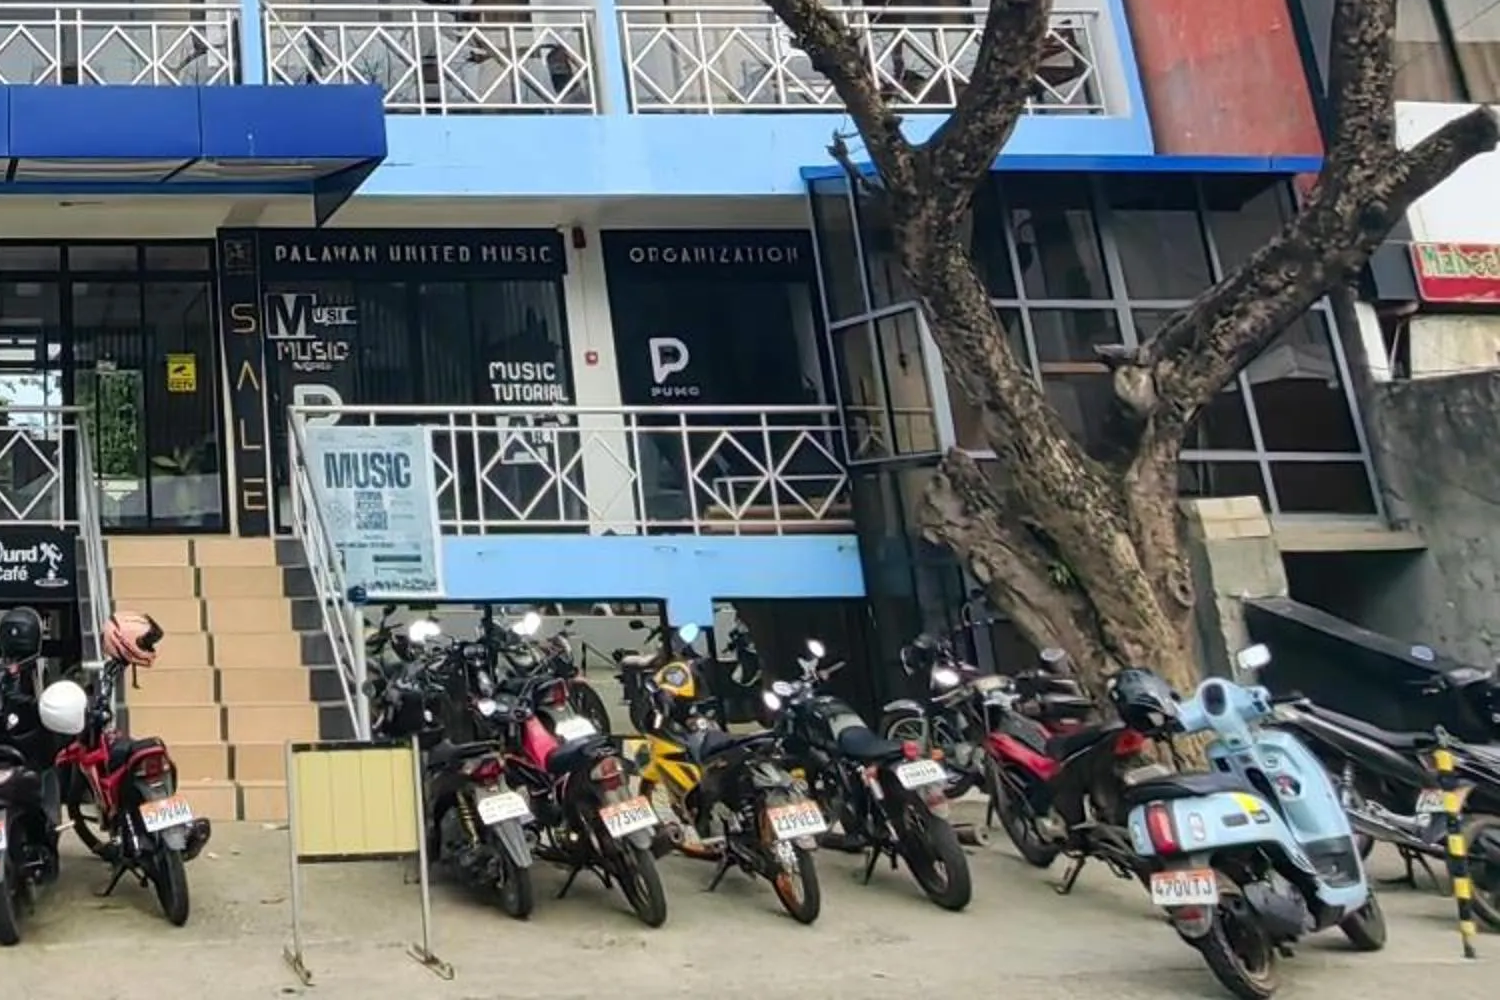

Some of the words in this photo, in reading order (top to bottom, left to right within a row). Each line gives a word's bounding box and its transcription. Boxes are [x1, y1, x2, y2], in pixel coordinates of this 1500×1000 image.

[275, 245, 377, 262] PALAWAN
[389, 245, 470, 262] UNITED
[482, 245, 553, 262] MUSIC
[629, 247, 799, 264] ORGANIZATION
[276, 341, 349, 361] MUSIC
[489, 361, 555, 380] MUSIC
[491, 383, 569, 402] TUTORIAL
[324, 452, 411, 489] MUSIC
